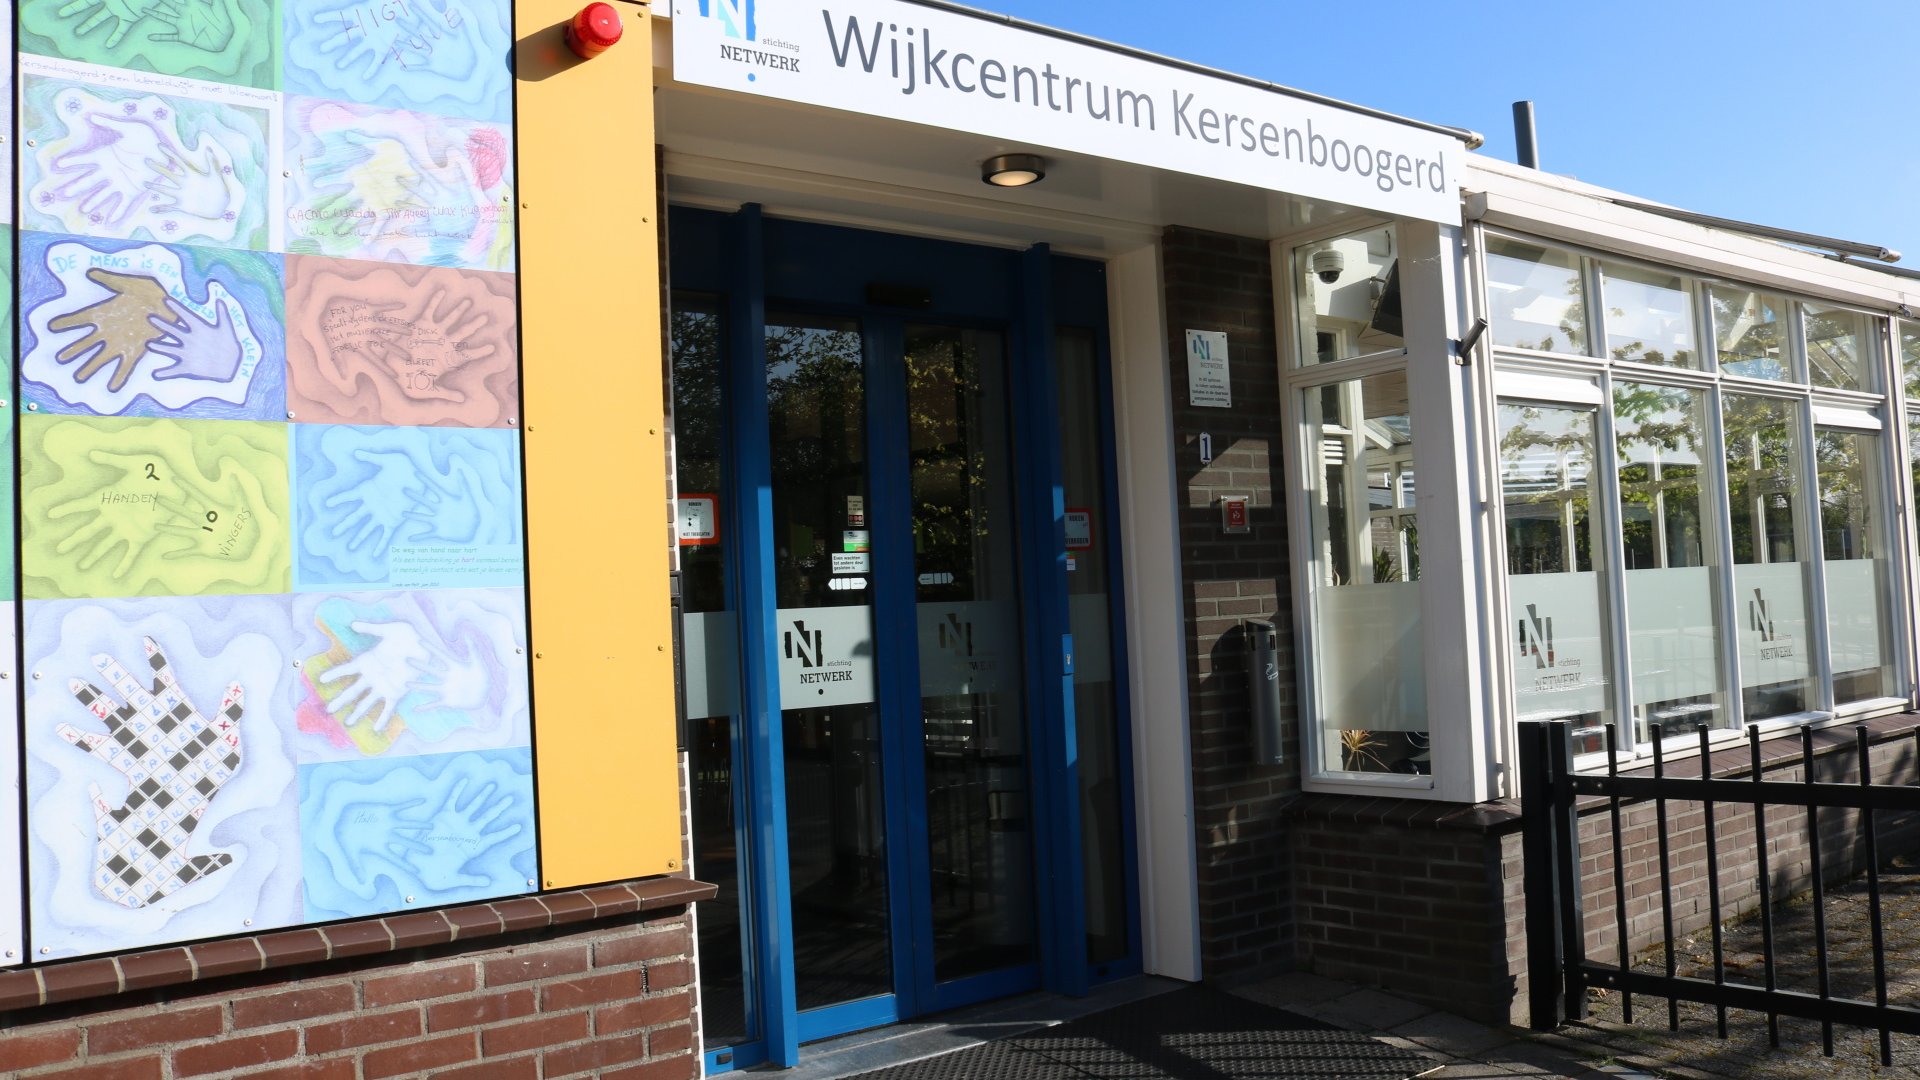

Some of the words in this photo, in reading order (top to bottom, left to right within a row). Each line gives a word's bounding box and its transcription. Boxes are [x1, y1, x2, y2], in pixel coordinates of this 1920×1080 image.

[762, 38, 800, 52] stichting
[720, 44, 800, 72] NETWERK
[822, 9, 1155, 131] Wijkcentrum
[1173, 89, 1446, 193] Kersenboogerd
[90, 254, 130, 268] MENS
[241, 336, 257, 378] KLEIN
[1202, 436, 1211, 461] 1
[145, 463, 160, 481] 2
[101, 491, 159, 511] HANDEN
[202, 510, 219, 532] 10
[800, 670, 853, 684] NETWERK
